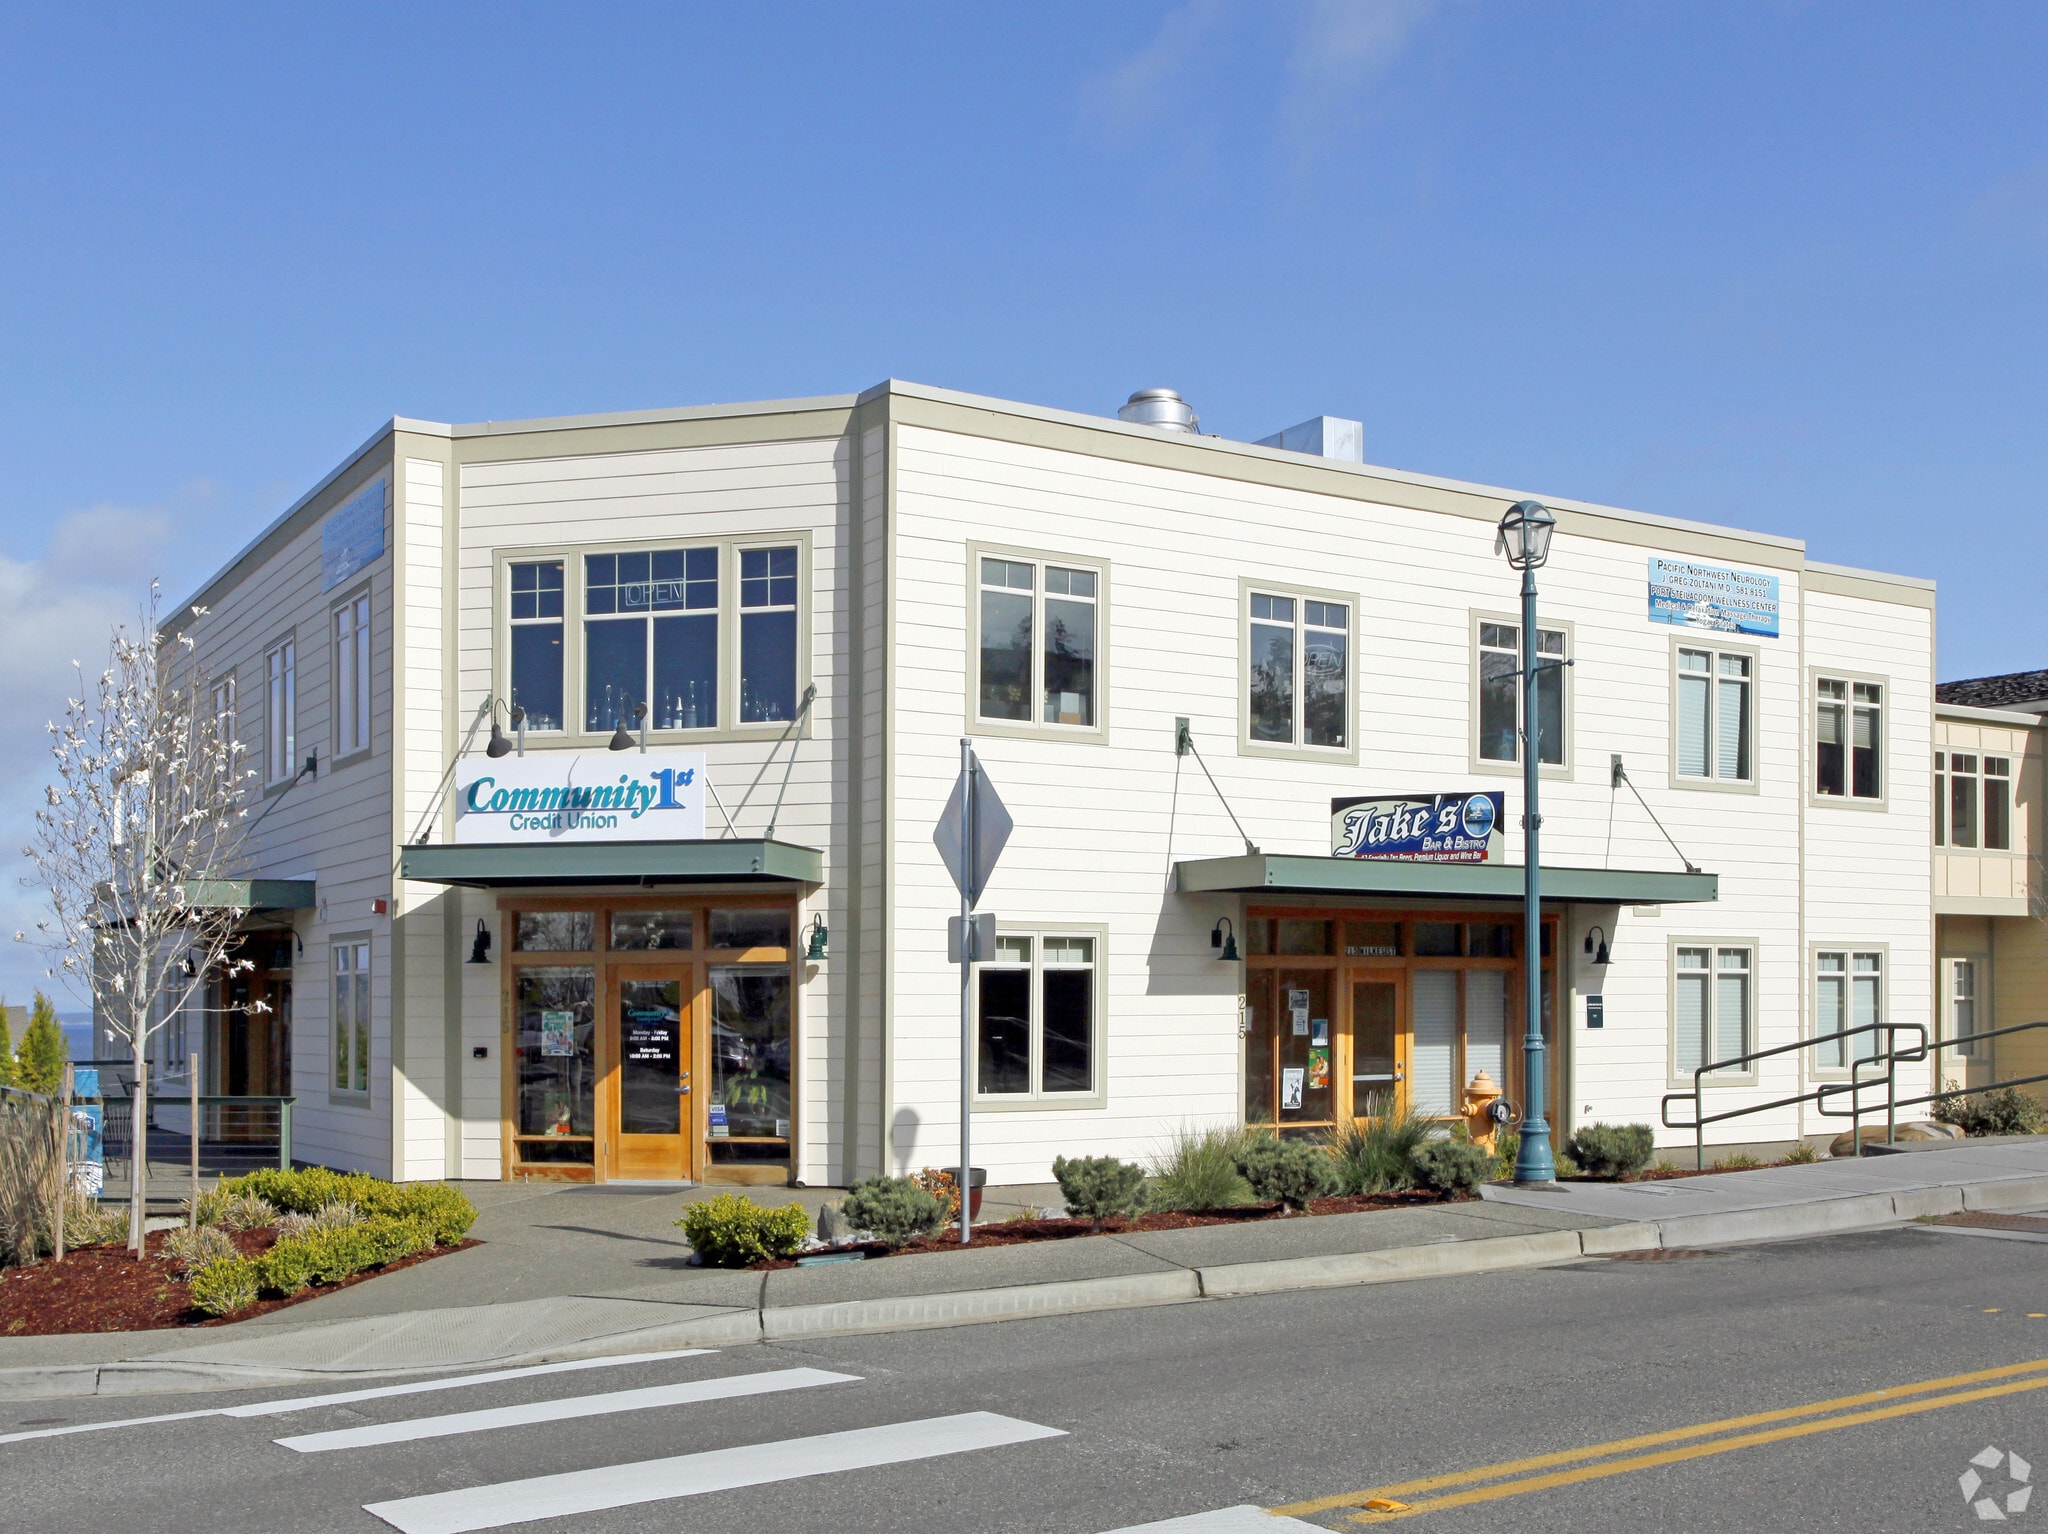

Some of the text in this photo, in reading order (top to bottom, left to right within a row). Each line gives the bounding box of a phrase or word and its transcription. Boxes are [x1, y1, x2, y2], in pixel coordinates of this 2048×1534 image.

[1657, 560, 1770, 587] PACIFIC NORTHWEST NEUROLOGY
[1669, 575, 1688, 586] GREG
[1689, 579, 1717, 590] ZOLTANI
[628, 583, 682, 603] OPEN
[1651, 586, 1777, 612] PORT STEILACOOM WELLNESS CENTER
[1655, 599, 1770, 624] Medical & Relaxation Massage Therapy
[467, 768, 695, 819] Community 1st
[510, 812, 617, 831] Credit Union
[1333, 795, 1461, 856] Jake's
[1443, 836, 1454, 850] &
[1414, 852, 1434, 862] Premium
[1434, 852, 1449, 862] Liquor
[1450, 852, 1460, 860] and
[1460, 851, 1472, 860] Wine
[1473, 851, 1482, 859] Bar
[1239, 996, 1247, 1039] 215
